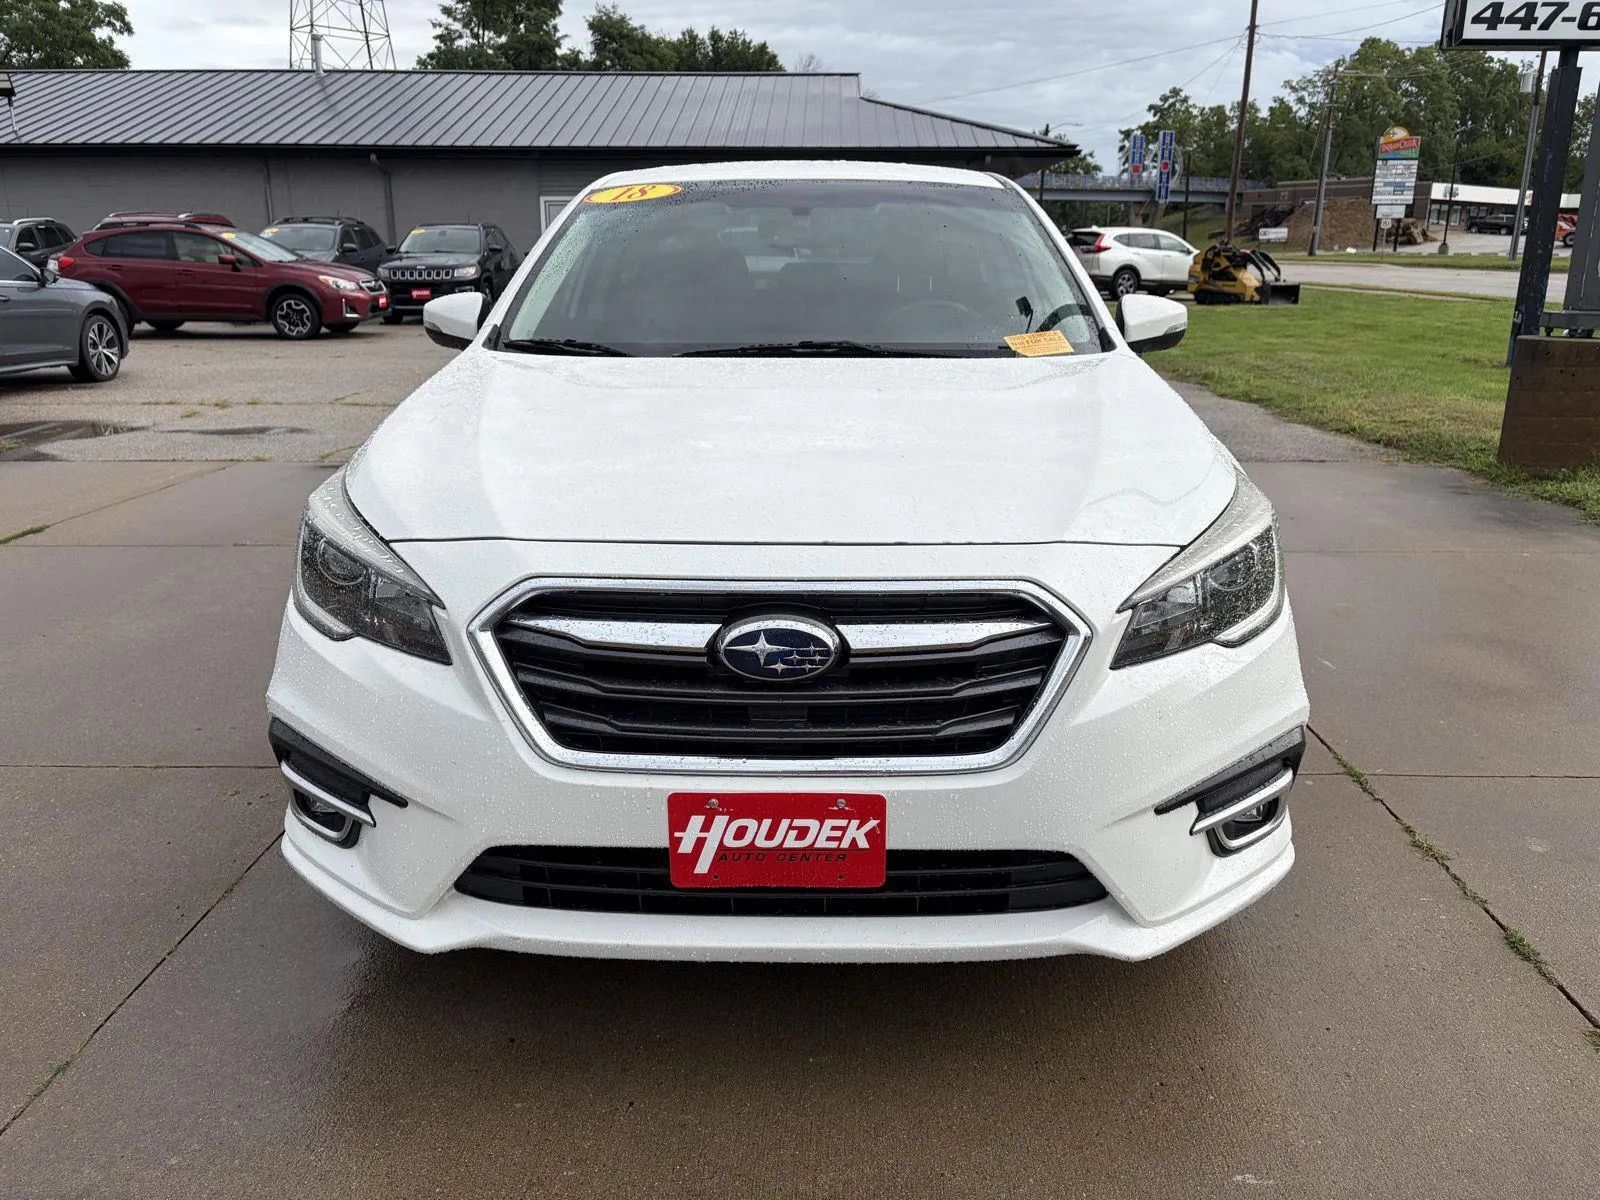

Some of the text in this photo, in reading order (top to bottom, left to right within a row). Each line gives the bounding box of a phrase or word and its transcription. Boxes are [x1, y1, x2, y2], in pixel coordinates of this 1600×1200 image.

[610, 185, 657, 200] 18
[674, 815, 880, 874] HOUDEK
[719, 853, 848, 862] AUTO CENTER
